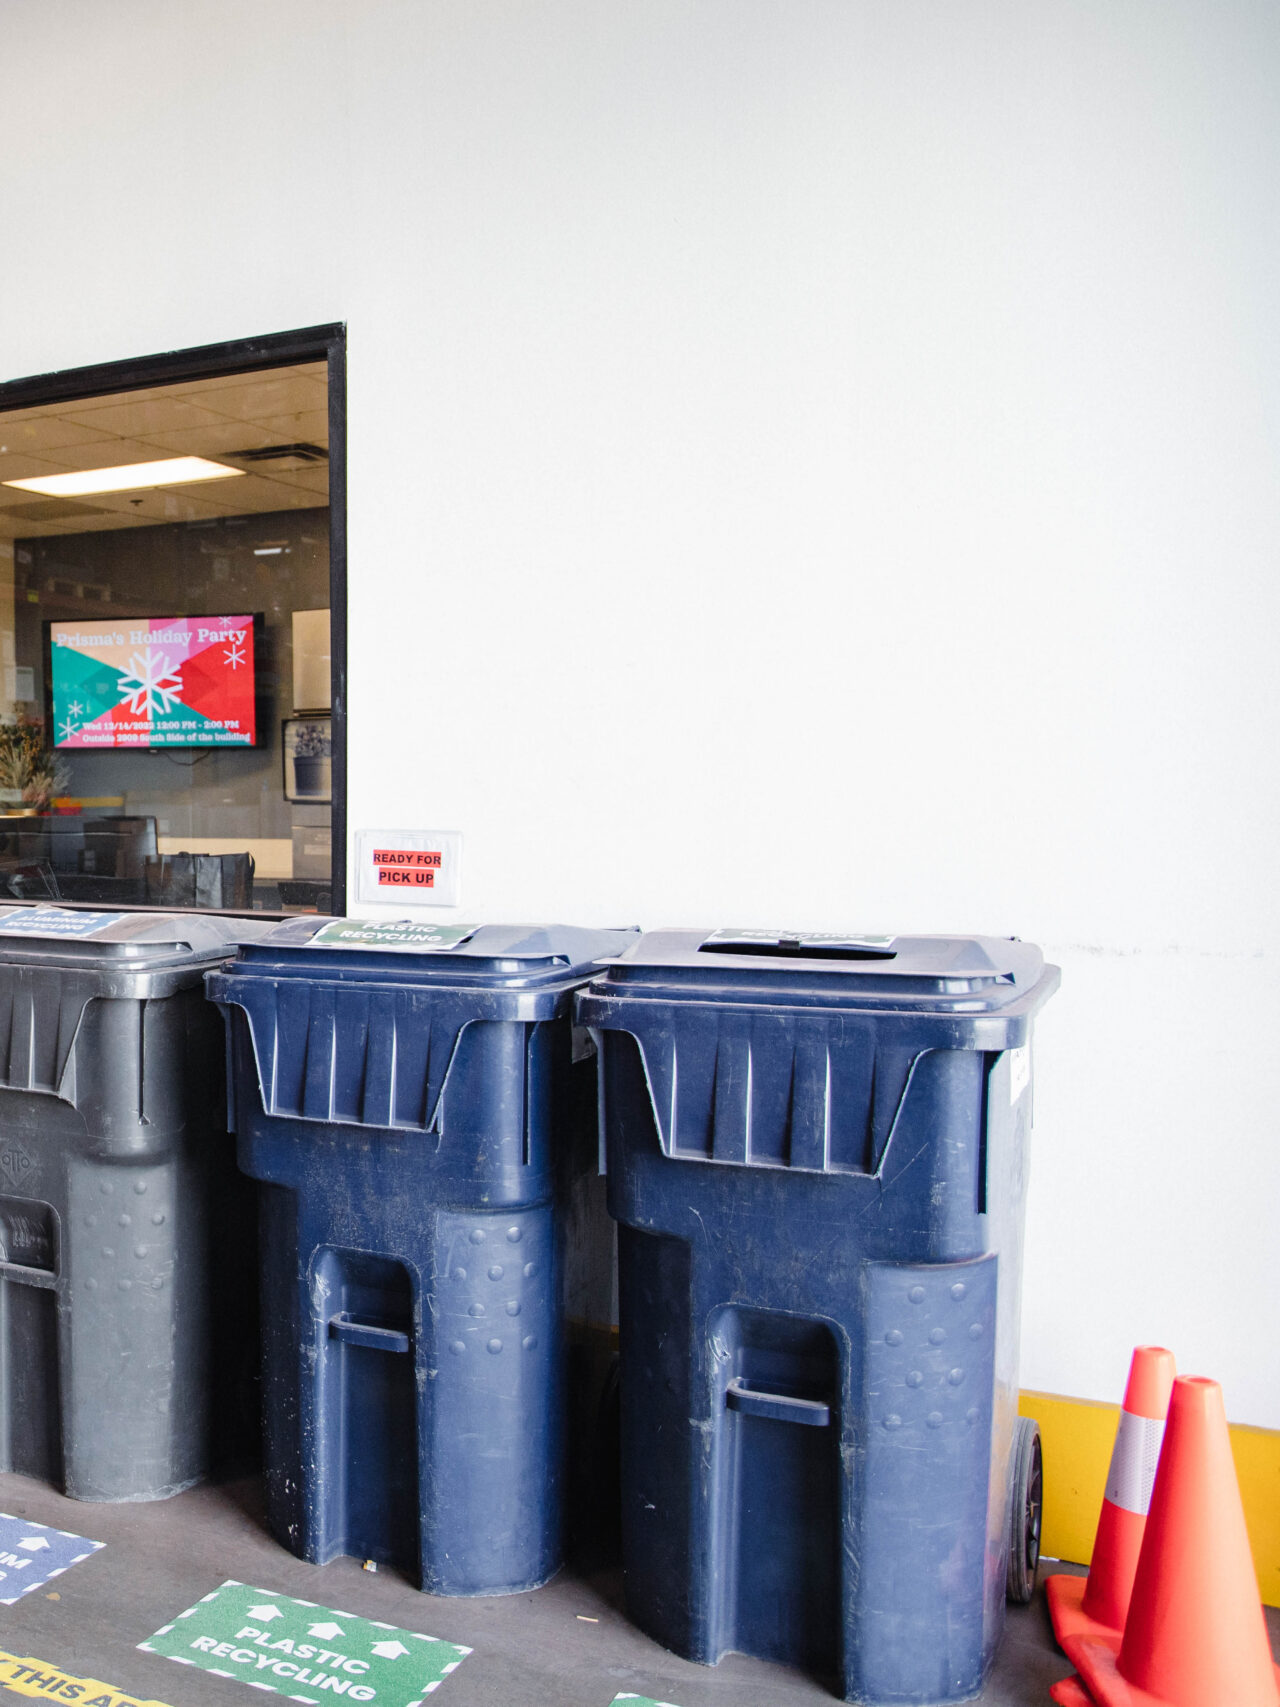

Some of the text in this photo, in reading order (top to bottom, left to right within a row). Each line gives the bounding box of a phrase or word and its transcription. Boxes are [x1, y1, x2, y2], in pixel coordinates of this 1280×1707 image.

[56, 628, 247, 647] Prisma's Holiday Party
[204, 721, 223, 730] 2:00
[224, 720, 240, 729] PM
[186, 732, 198, 742] of
[198, 732, 214, 742] the
[373, 853, 441, 865] READY FOR
[379, 871, 434, 884] PICK UP
[362, 923, 438, 933] PLASTIC
[340, 930, 443, 942] RECYCLING
[234, 1626, 371, 1675] PLASTIC
[189, 1635, 377, 1701] RECYCLING
[8, 1663, 87, 1700] THIS
